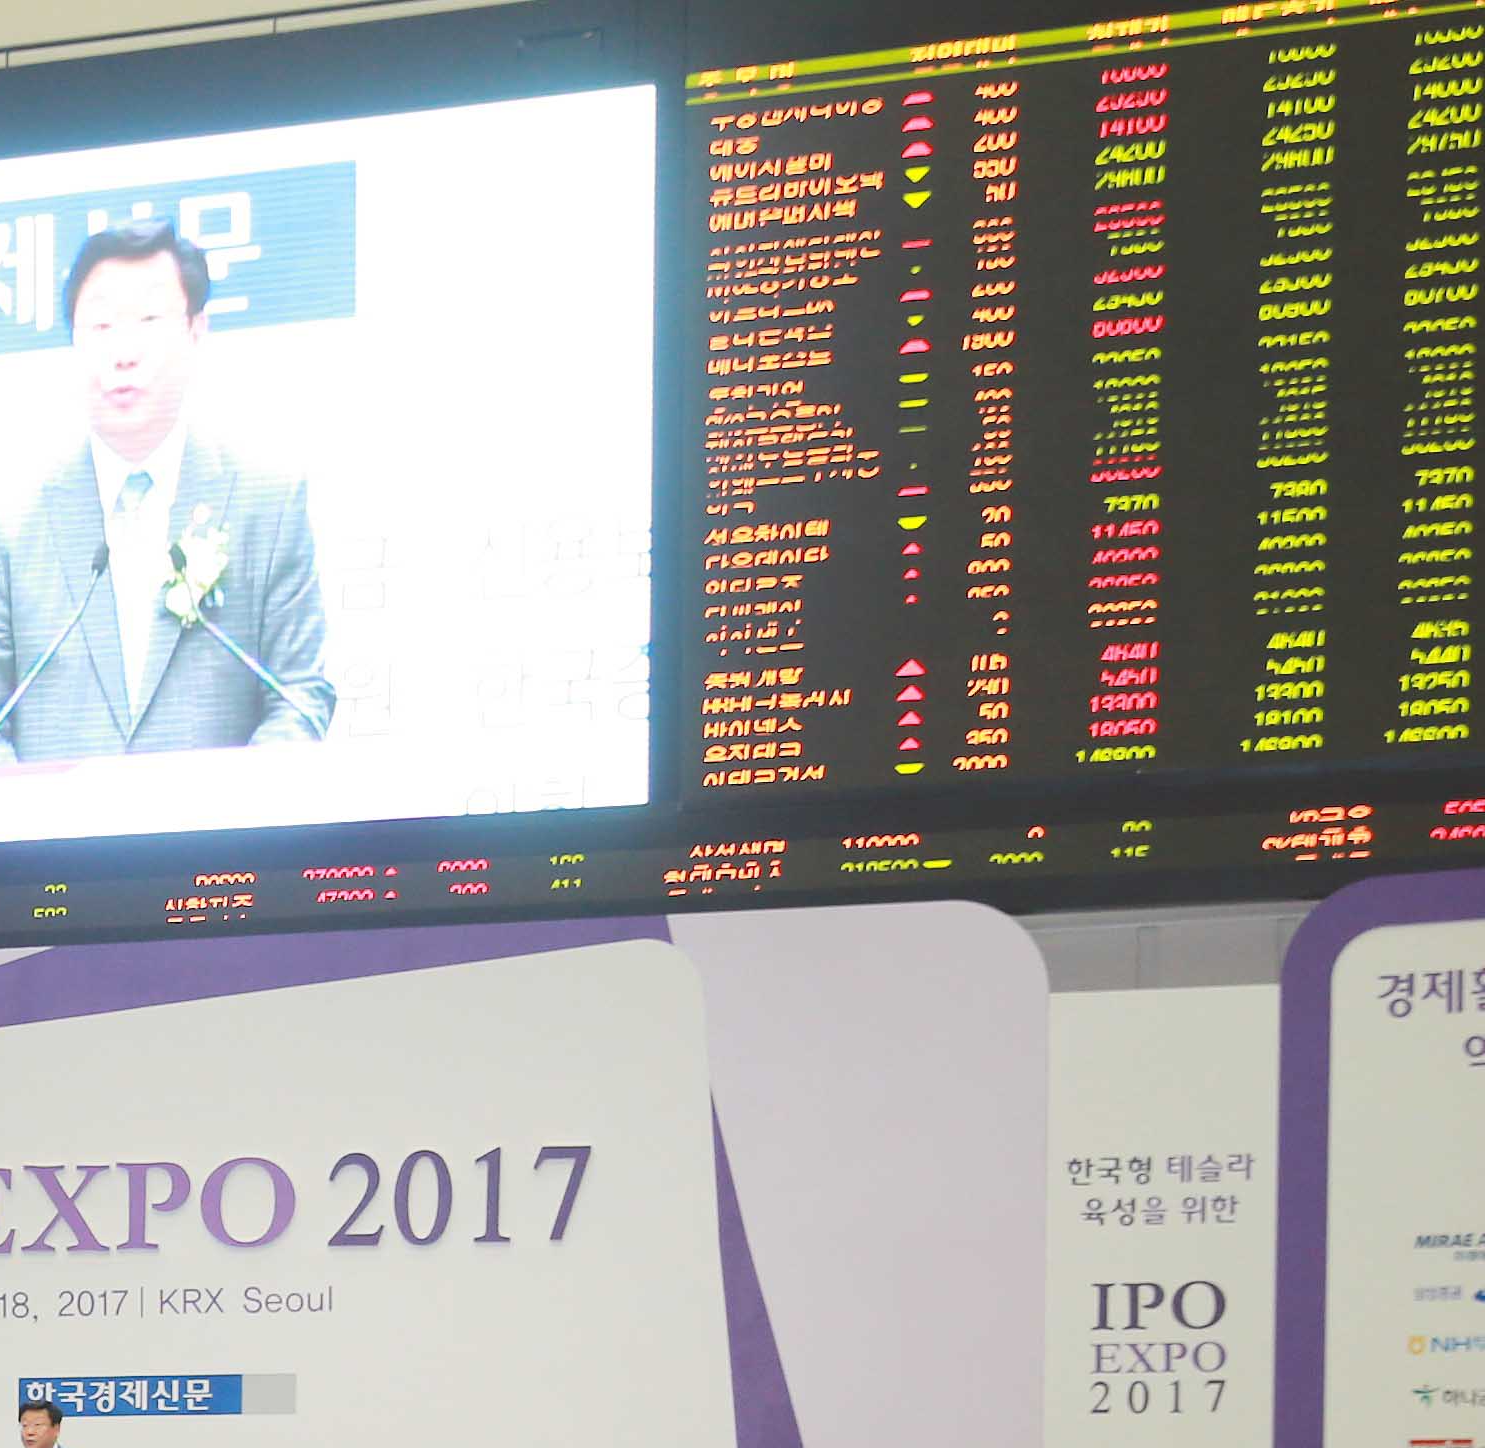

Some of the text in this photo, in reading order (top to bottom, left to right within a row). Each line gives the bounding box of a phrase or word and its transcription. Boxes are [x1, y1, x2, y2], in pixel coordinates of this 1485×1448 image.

[1069, 1153, 1255, 1185] 한국형 테슬라
[328, 1144, 593, 1248] 2017
[1081, 1195, 1239, 1226] 육성을 위한
[0, 1292, 37, 1321] 18,
[59, 1290, 128, 1316] 2017
[160, 1288, 223, 1314] KRX
[243, 1286, 332, 1313] Seoul
[1092, 1281, 1225, 1330] IPO
[1092, 1342, 1226, 1373] EXPO
[26, 1378, 215, 1413] 한국경제신문
[1091, 1380, 1225, 1413] 2017
